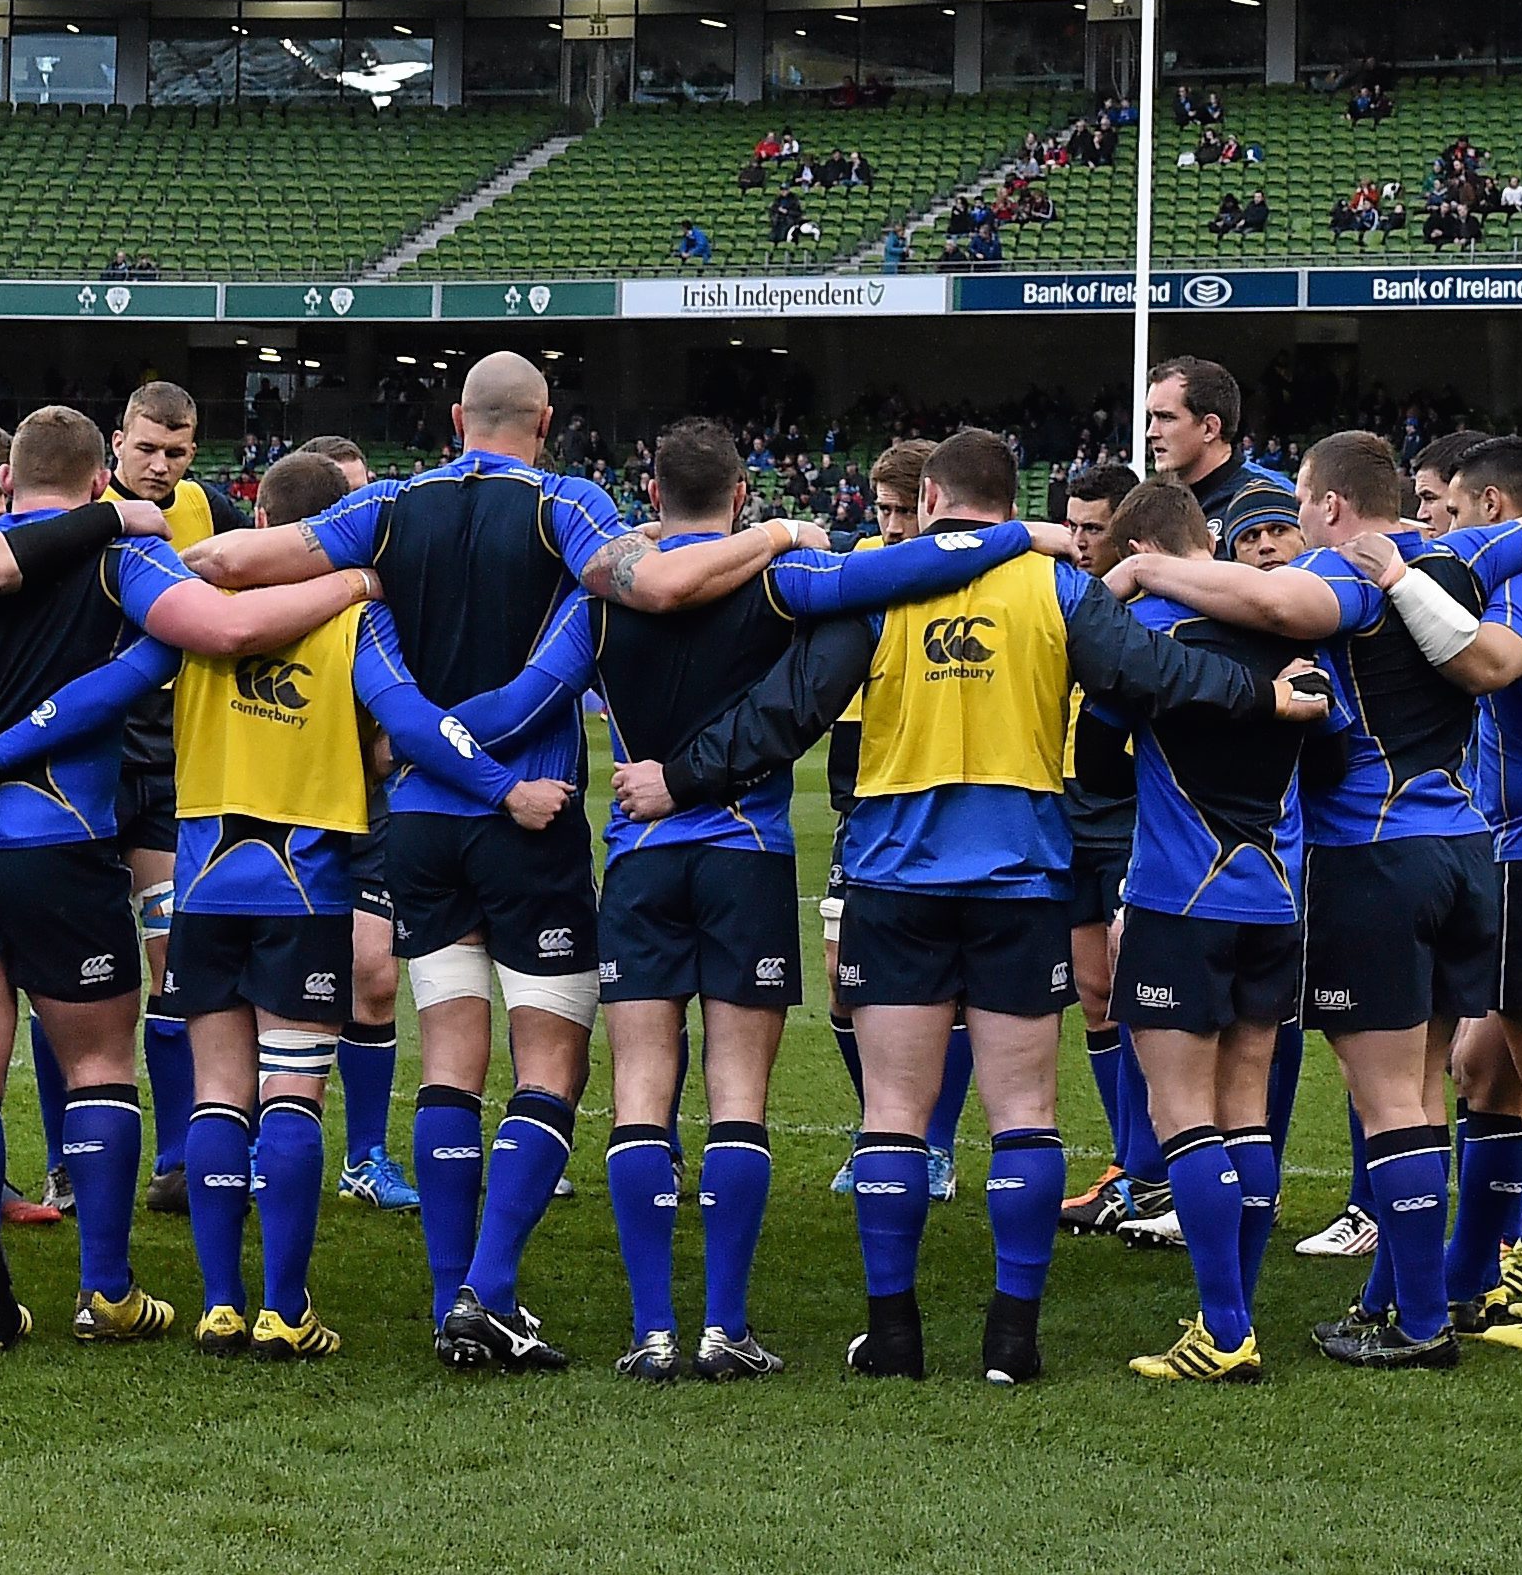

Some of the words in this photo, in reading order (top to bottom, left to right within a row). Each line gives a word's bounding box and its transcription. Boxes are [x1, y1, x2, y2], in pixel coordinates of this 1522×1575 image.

[588, 25, 609, 36] 313
[682, 283, 728, 307] Irish
[735, 281, 865, 312] Independent
[1024, 282, 1075, 304] Bank
[1077, 281, 1100, 304] of
[1373, 278, 1427, 300] Bank
[1430, 277, 1454, 299] of
[924, 663, 995, 683] cantebury
[229, 698, 309, 731] canterbury
[1136, 982, 1169, 1002] laya
[1314, 988, 1346, 1005] laya
